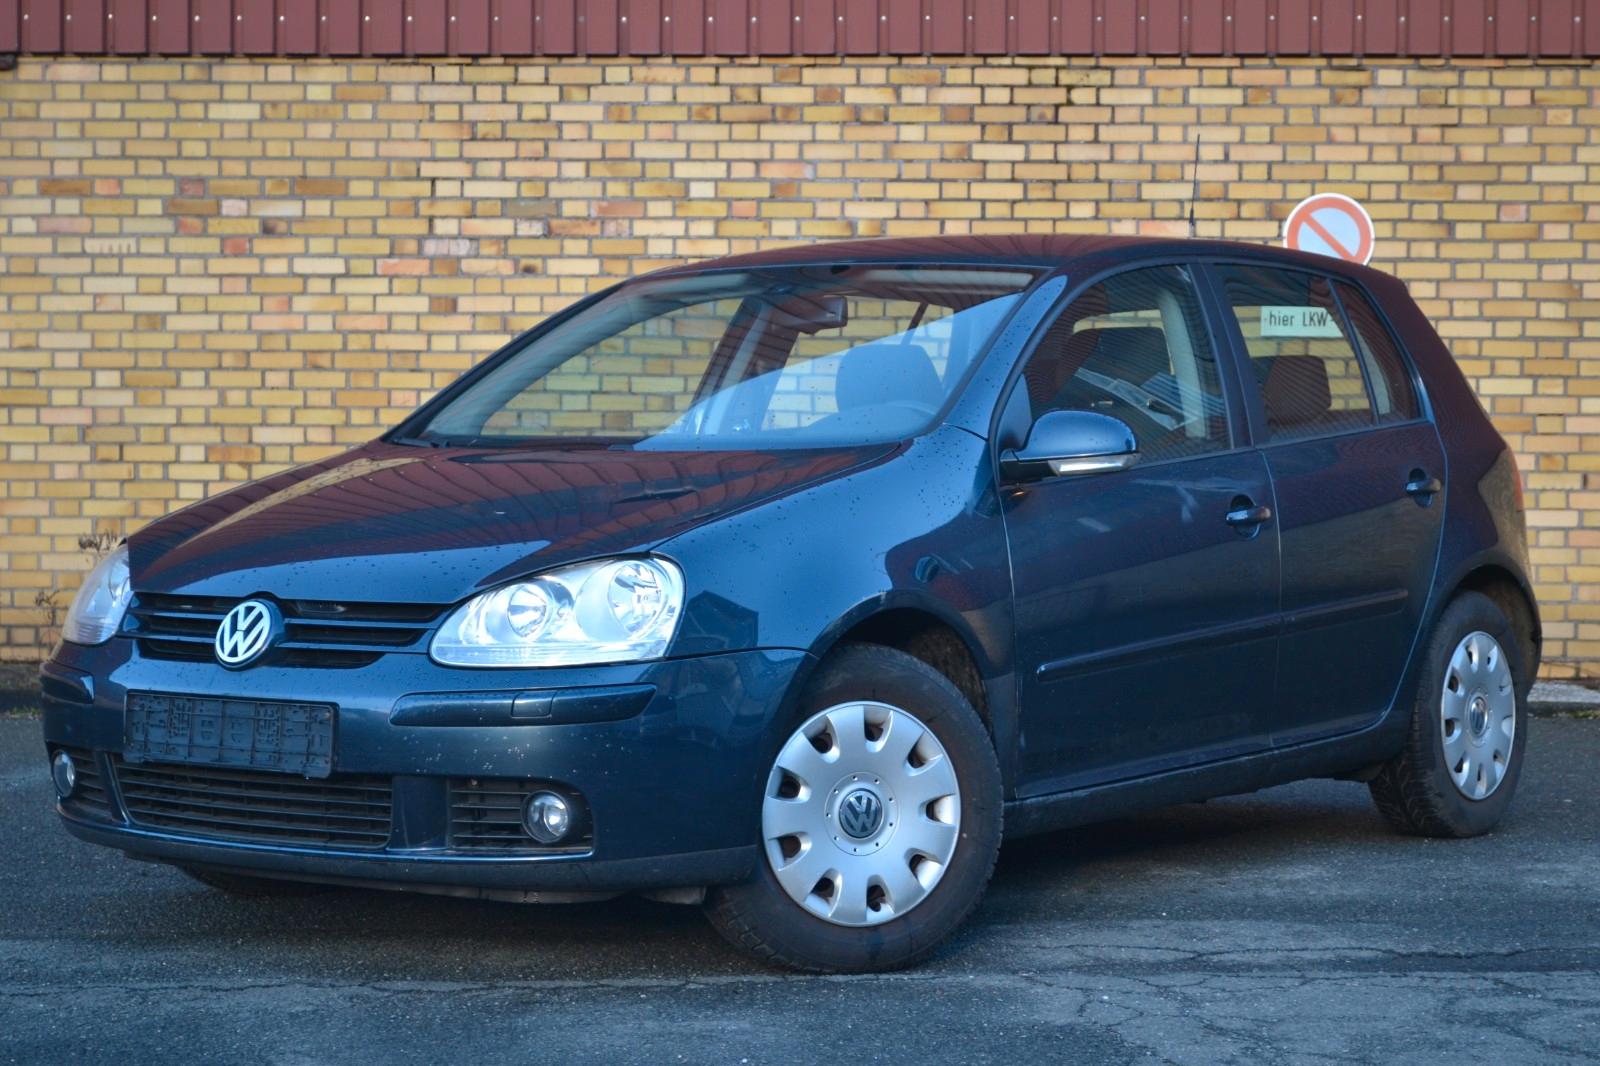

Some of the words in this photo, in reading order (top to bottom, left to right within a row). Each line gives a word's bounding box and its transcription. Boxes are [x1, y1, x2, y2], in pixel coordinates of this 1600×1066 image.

[1269, 311, 1295, 327] hier
[1302, 311, 1329, 327] LKW
[217, 602, 269, 662] VW
[842, 791, 881, 837] VW
